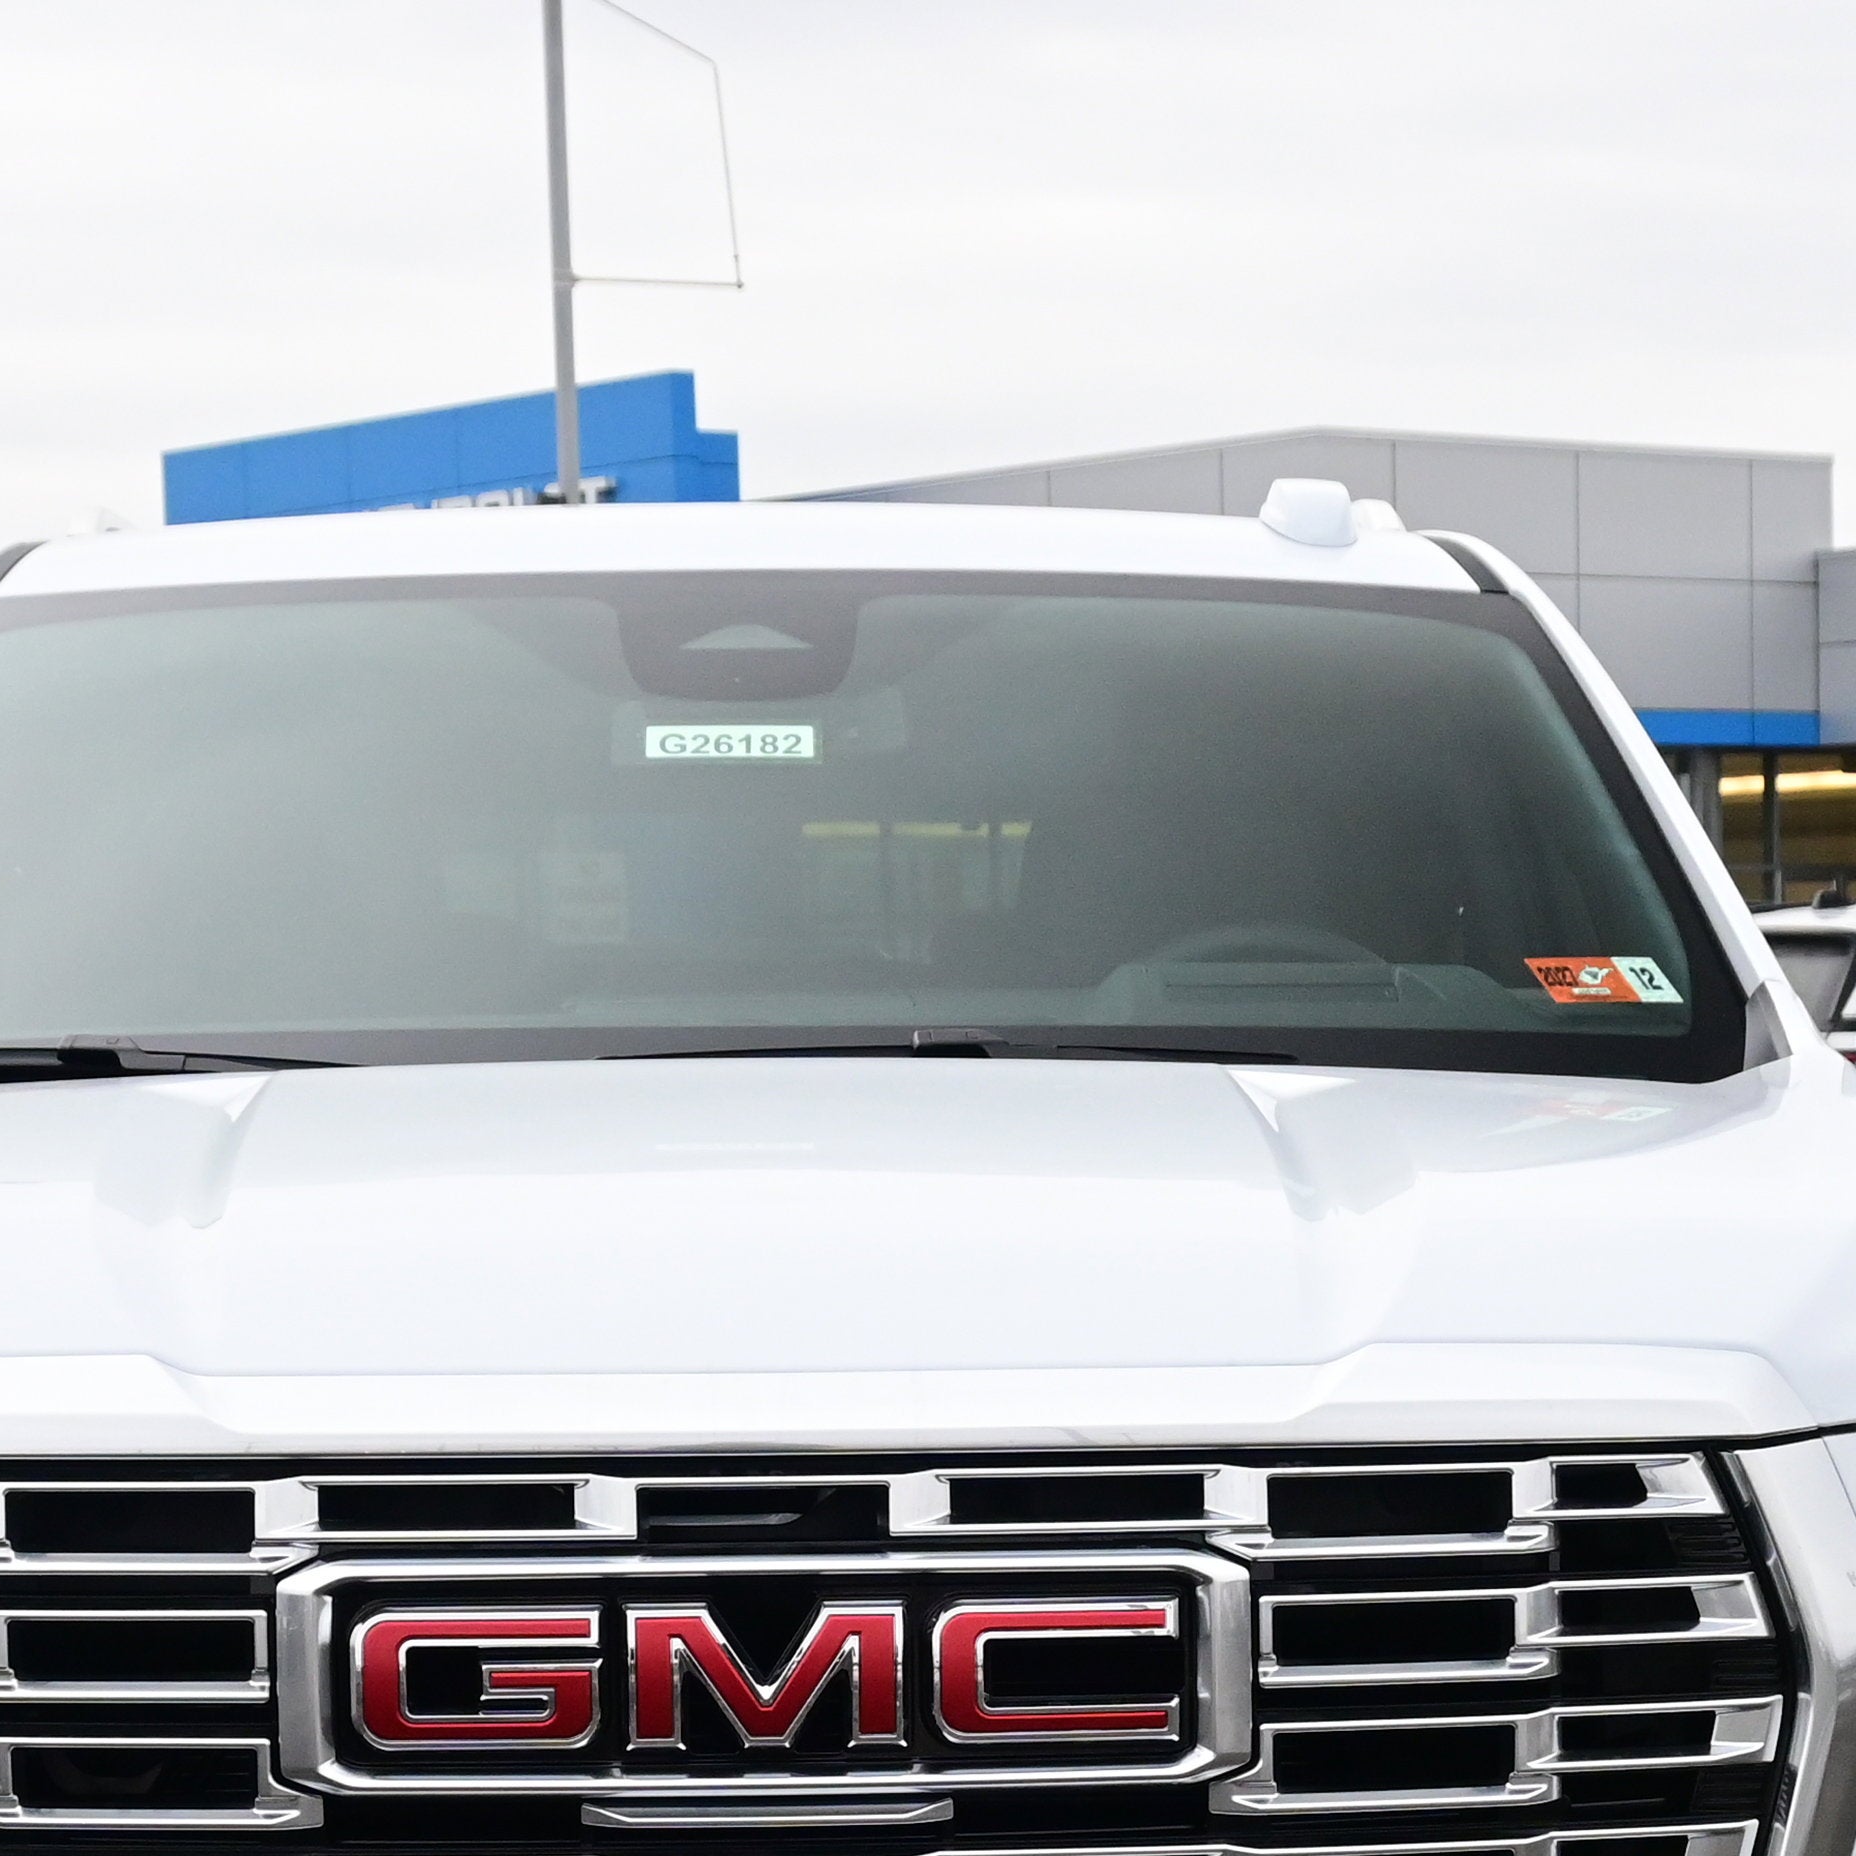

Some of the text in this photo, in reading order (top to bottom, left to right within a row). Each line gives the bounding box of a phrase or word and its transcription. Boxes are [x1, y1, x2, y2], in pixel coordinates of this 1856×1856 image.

[657, 732, 803, 756] G26182
[1628, 966, 1665, 990] 12
[348, 1599, 1180, 1752] GMC
